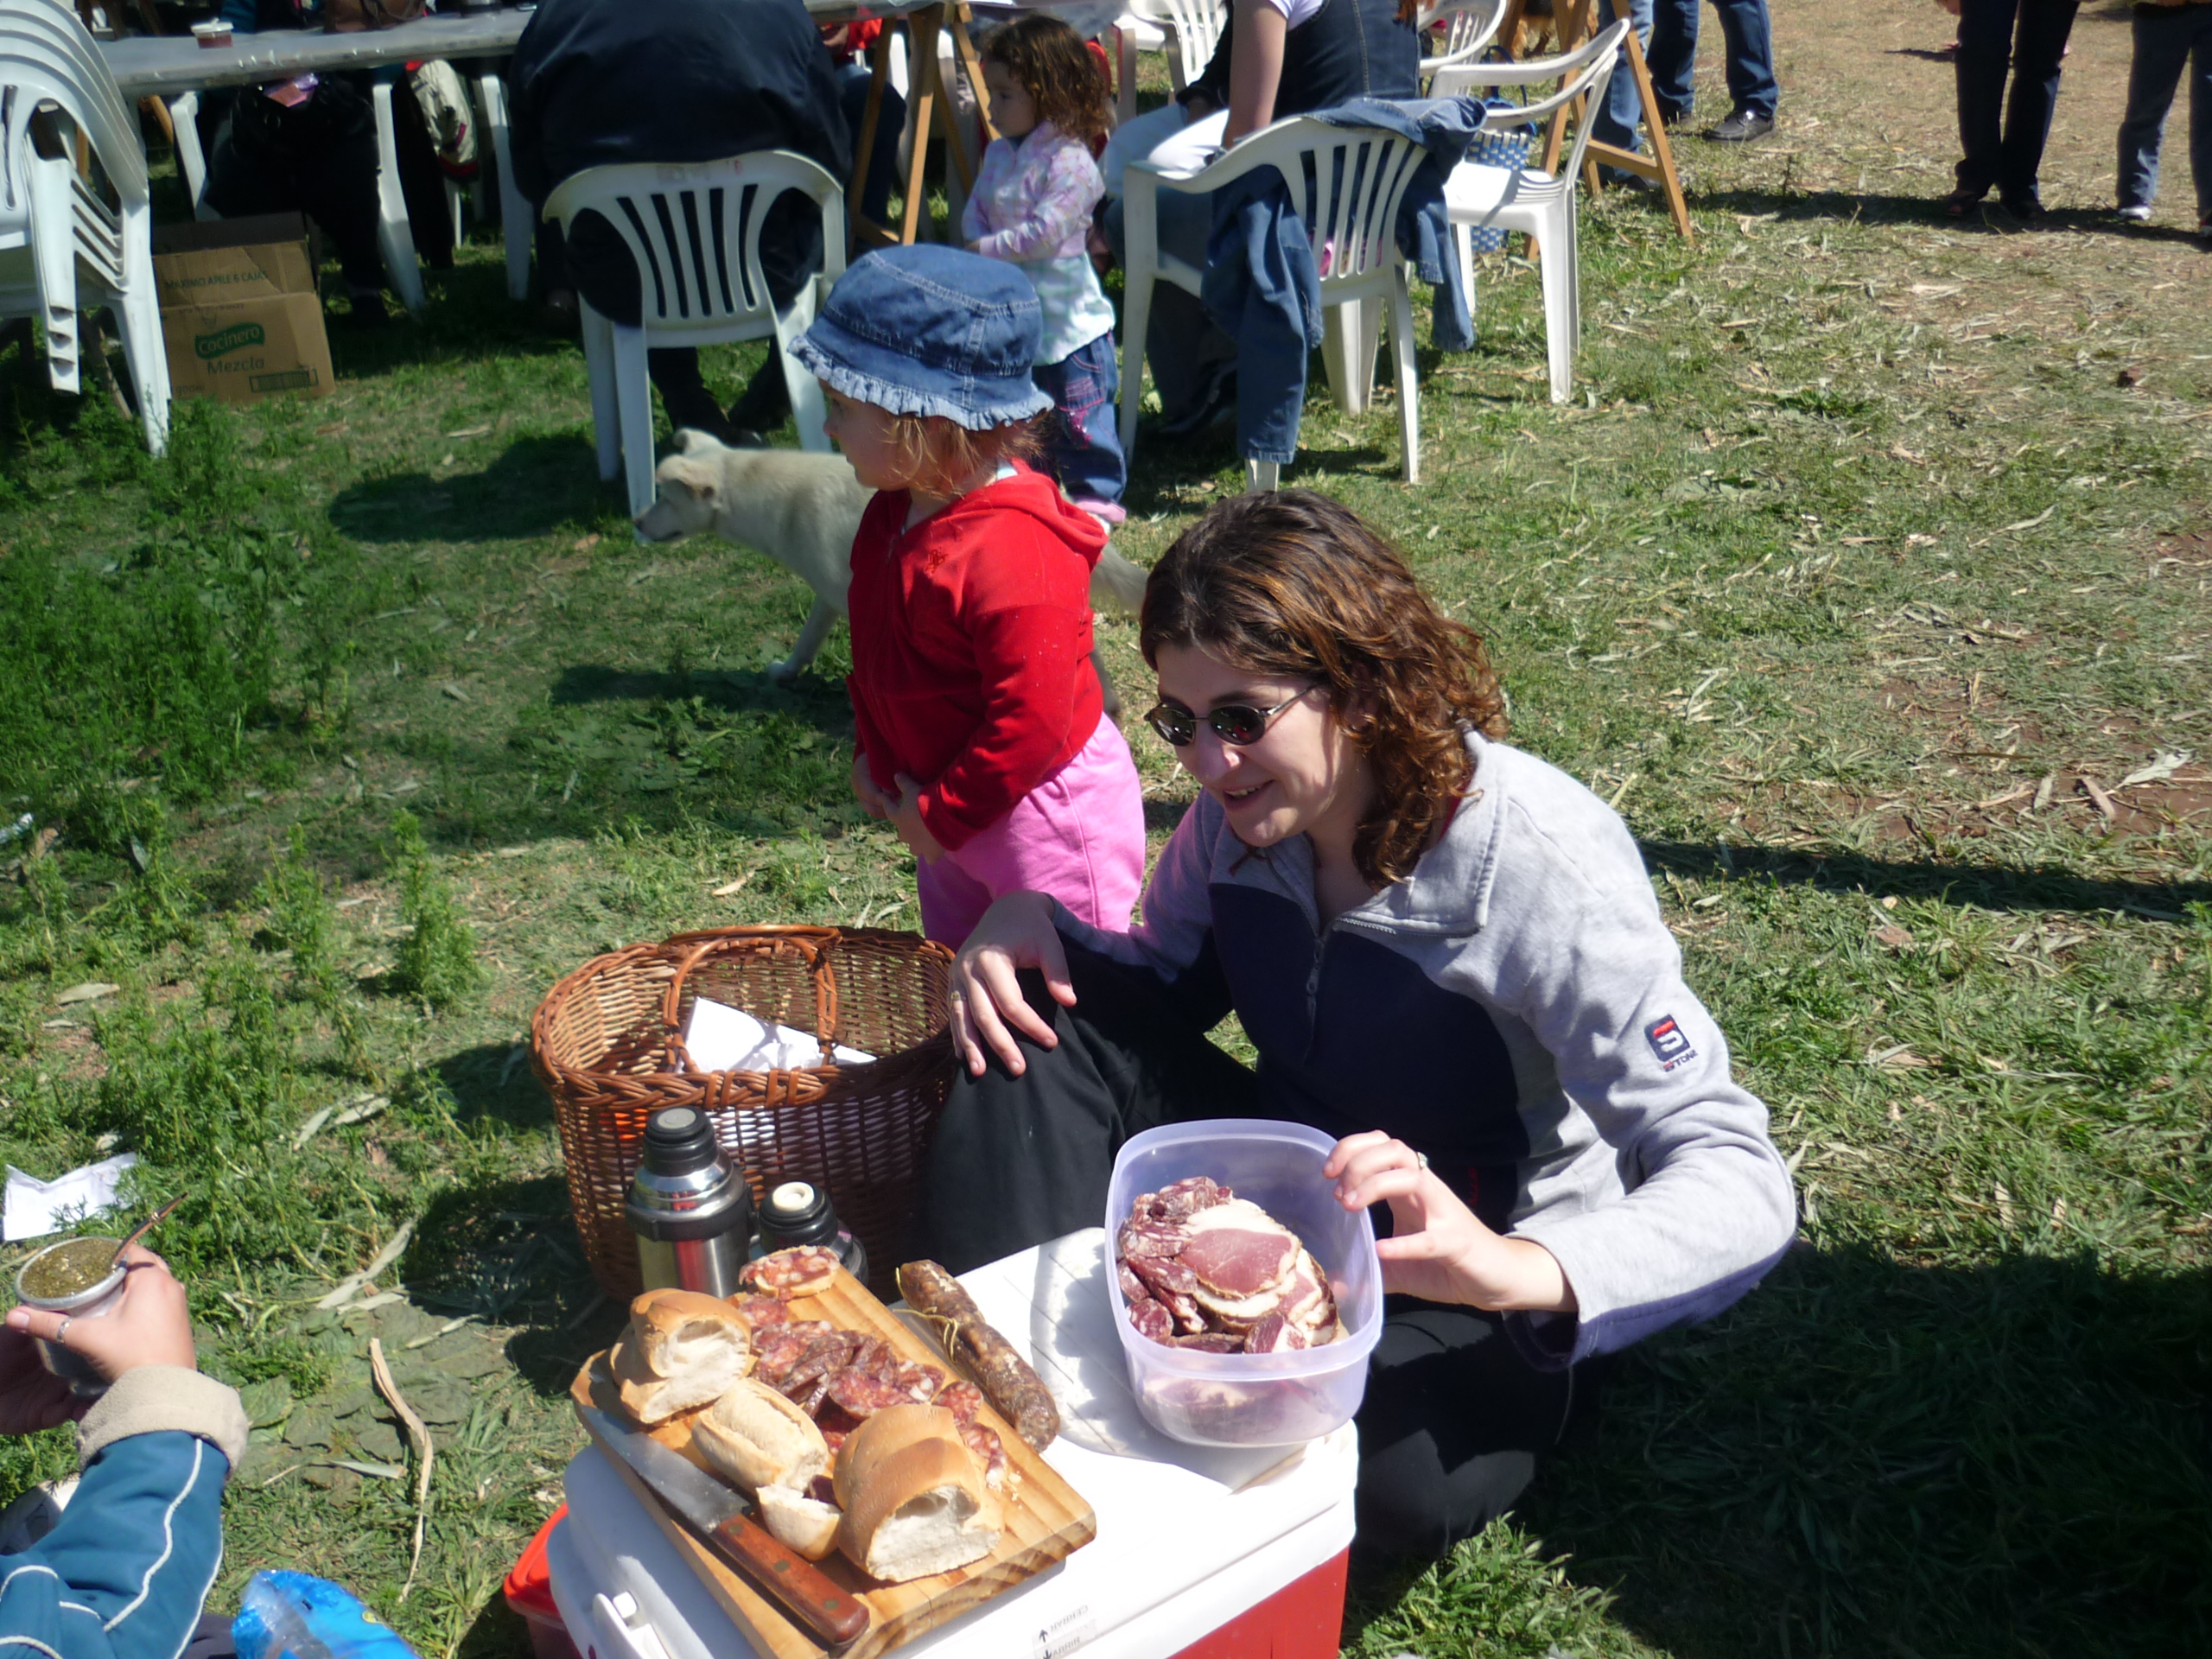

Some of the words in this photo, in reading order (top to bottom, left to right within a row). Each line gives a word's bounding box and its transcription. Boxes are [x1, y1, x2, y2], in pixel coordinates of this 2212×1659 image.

[199, 326, 260, 354] Cocinero
[207, 355, 265, 374] Mezcla
[1662, 1048, 1699, 1072] STONE
[1051, 1605, 1088, 1631] CERRAR
[1052, 1636, 1080, 1656] ABRIR
